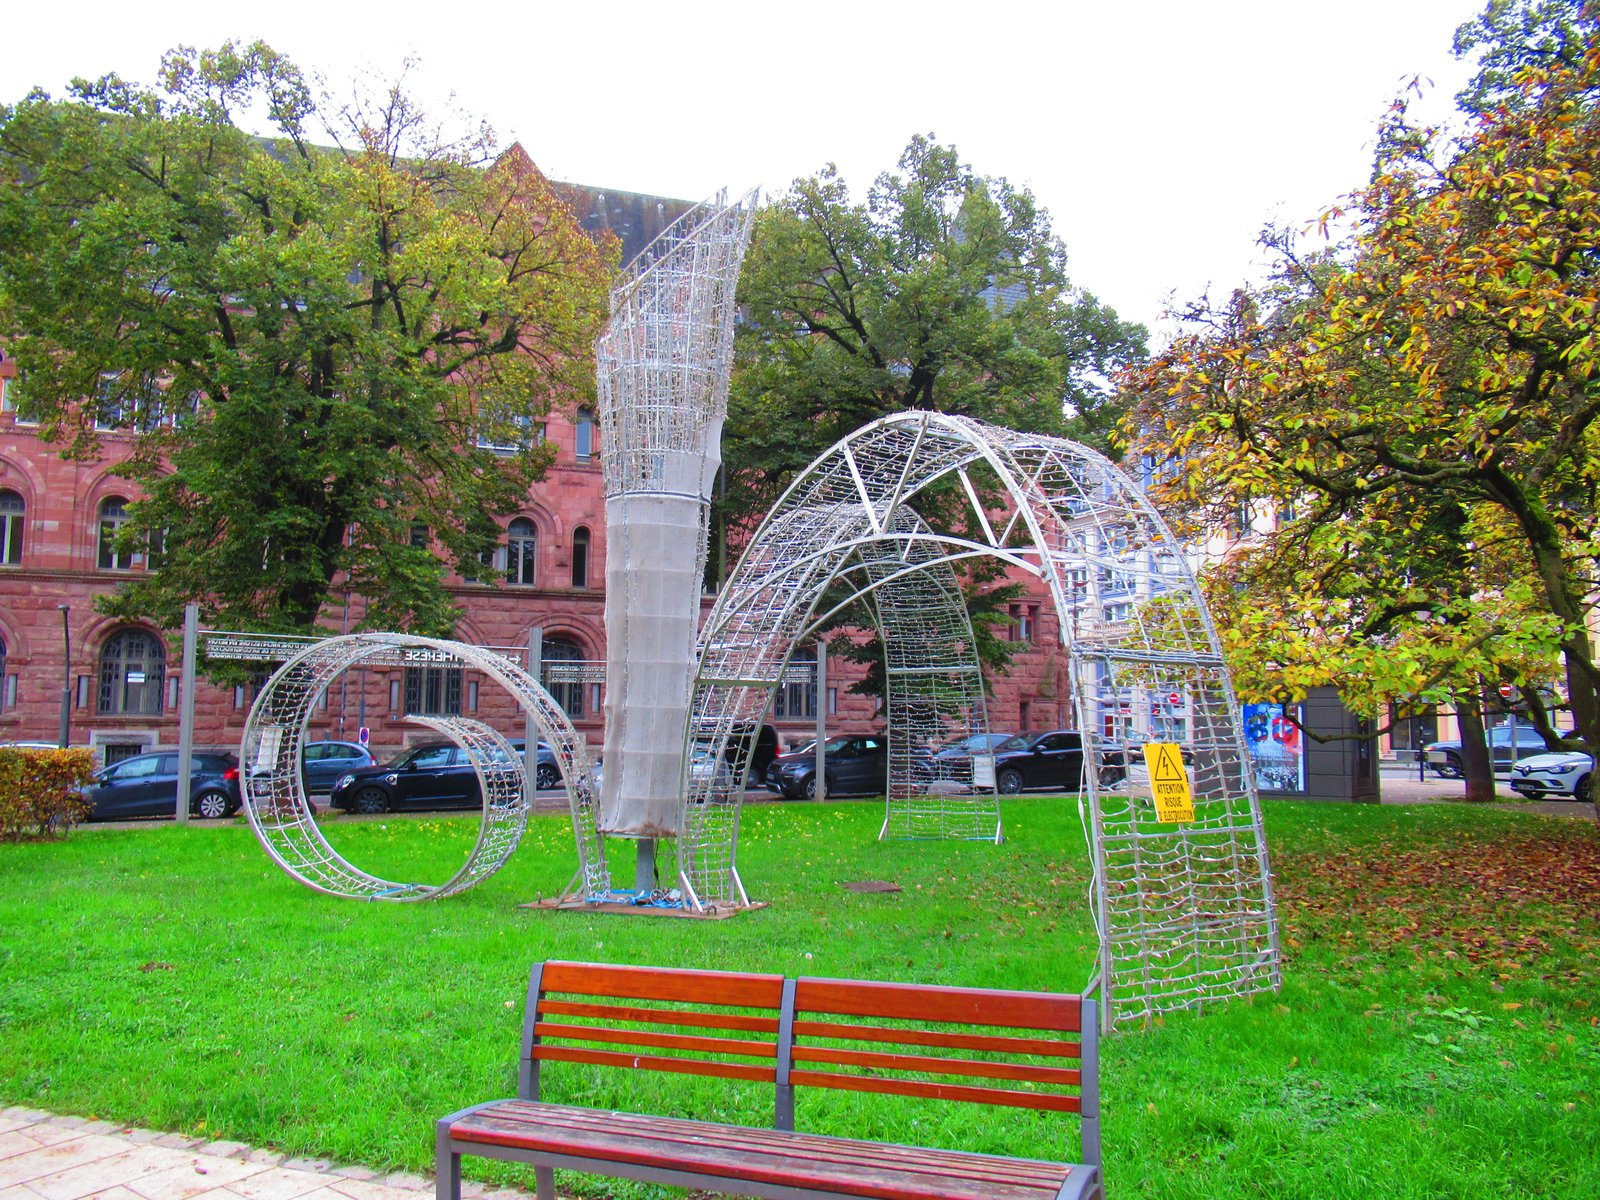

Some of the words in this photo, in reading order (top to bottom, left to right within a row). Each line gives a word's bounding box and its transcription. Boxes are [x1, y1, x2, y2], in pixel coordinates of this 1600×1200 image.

[1248, 714, 1295, 744] 80
[1157, 783, 1185, 794] ATTENTION
[1164, 796, 1183, 808] RISQUE
